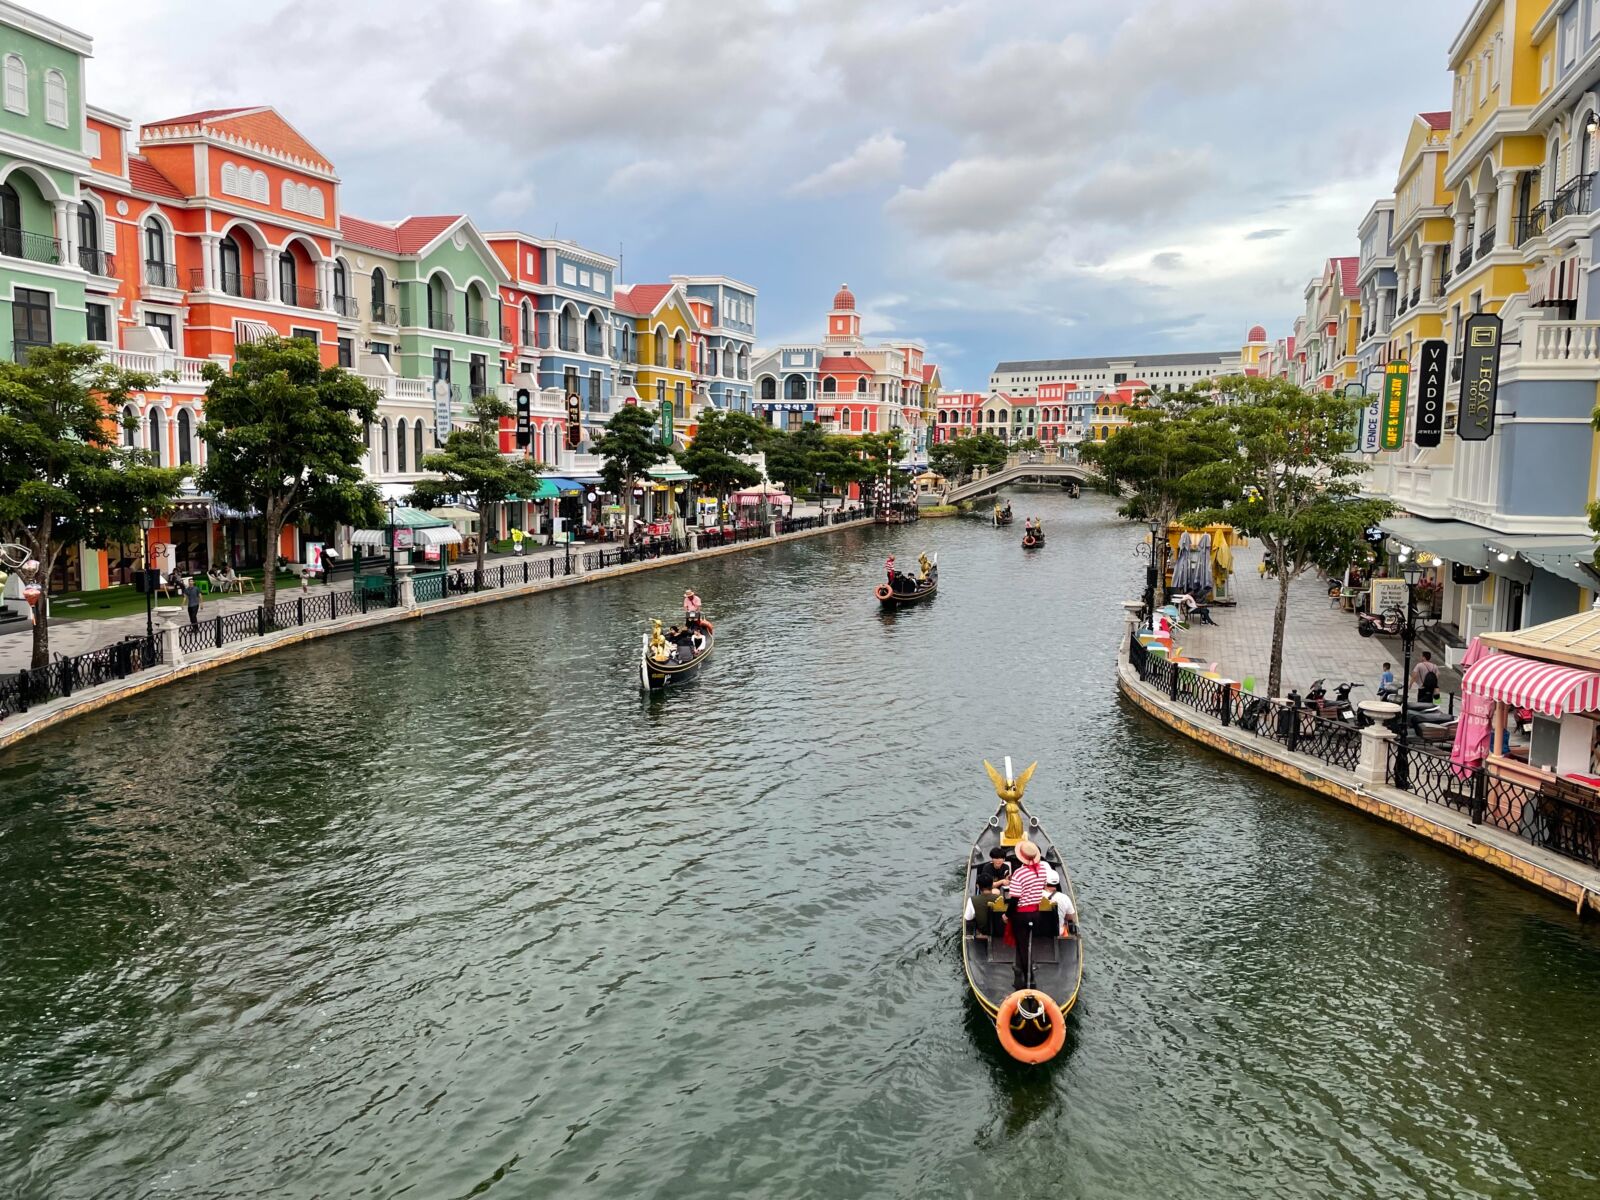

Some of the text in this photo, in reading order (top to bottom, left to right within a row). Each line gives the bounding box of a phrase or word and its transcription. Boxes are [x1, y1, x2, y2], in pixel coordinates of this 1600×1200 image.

[1424, 348, 1440, 423] VAADOO
[1468, 380, 1478, 417] HOTEL
[1476, 355, 1494, 431] LEGACY
[1366, 392, 1380, 449] VENICE CA
[1386, 427, 1398, 446] CAFE
